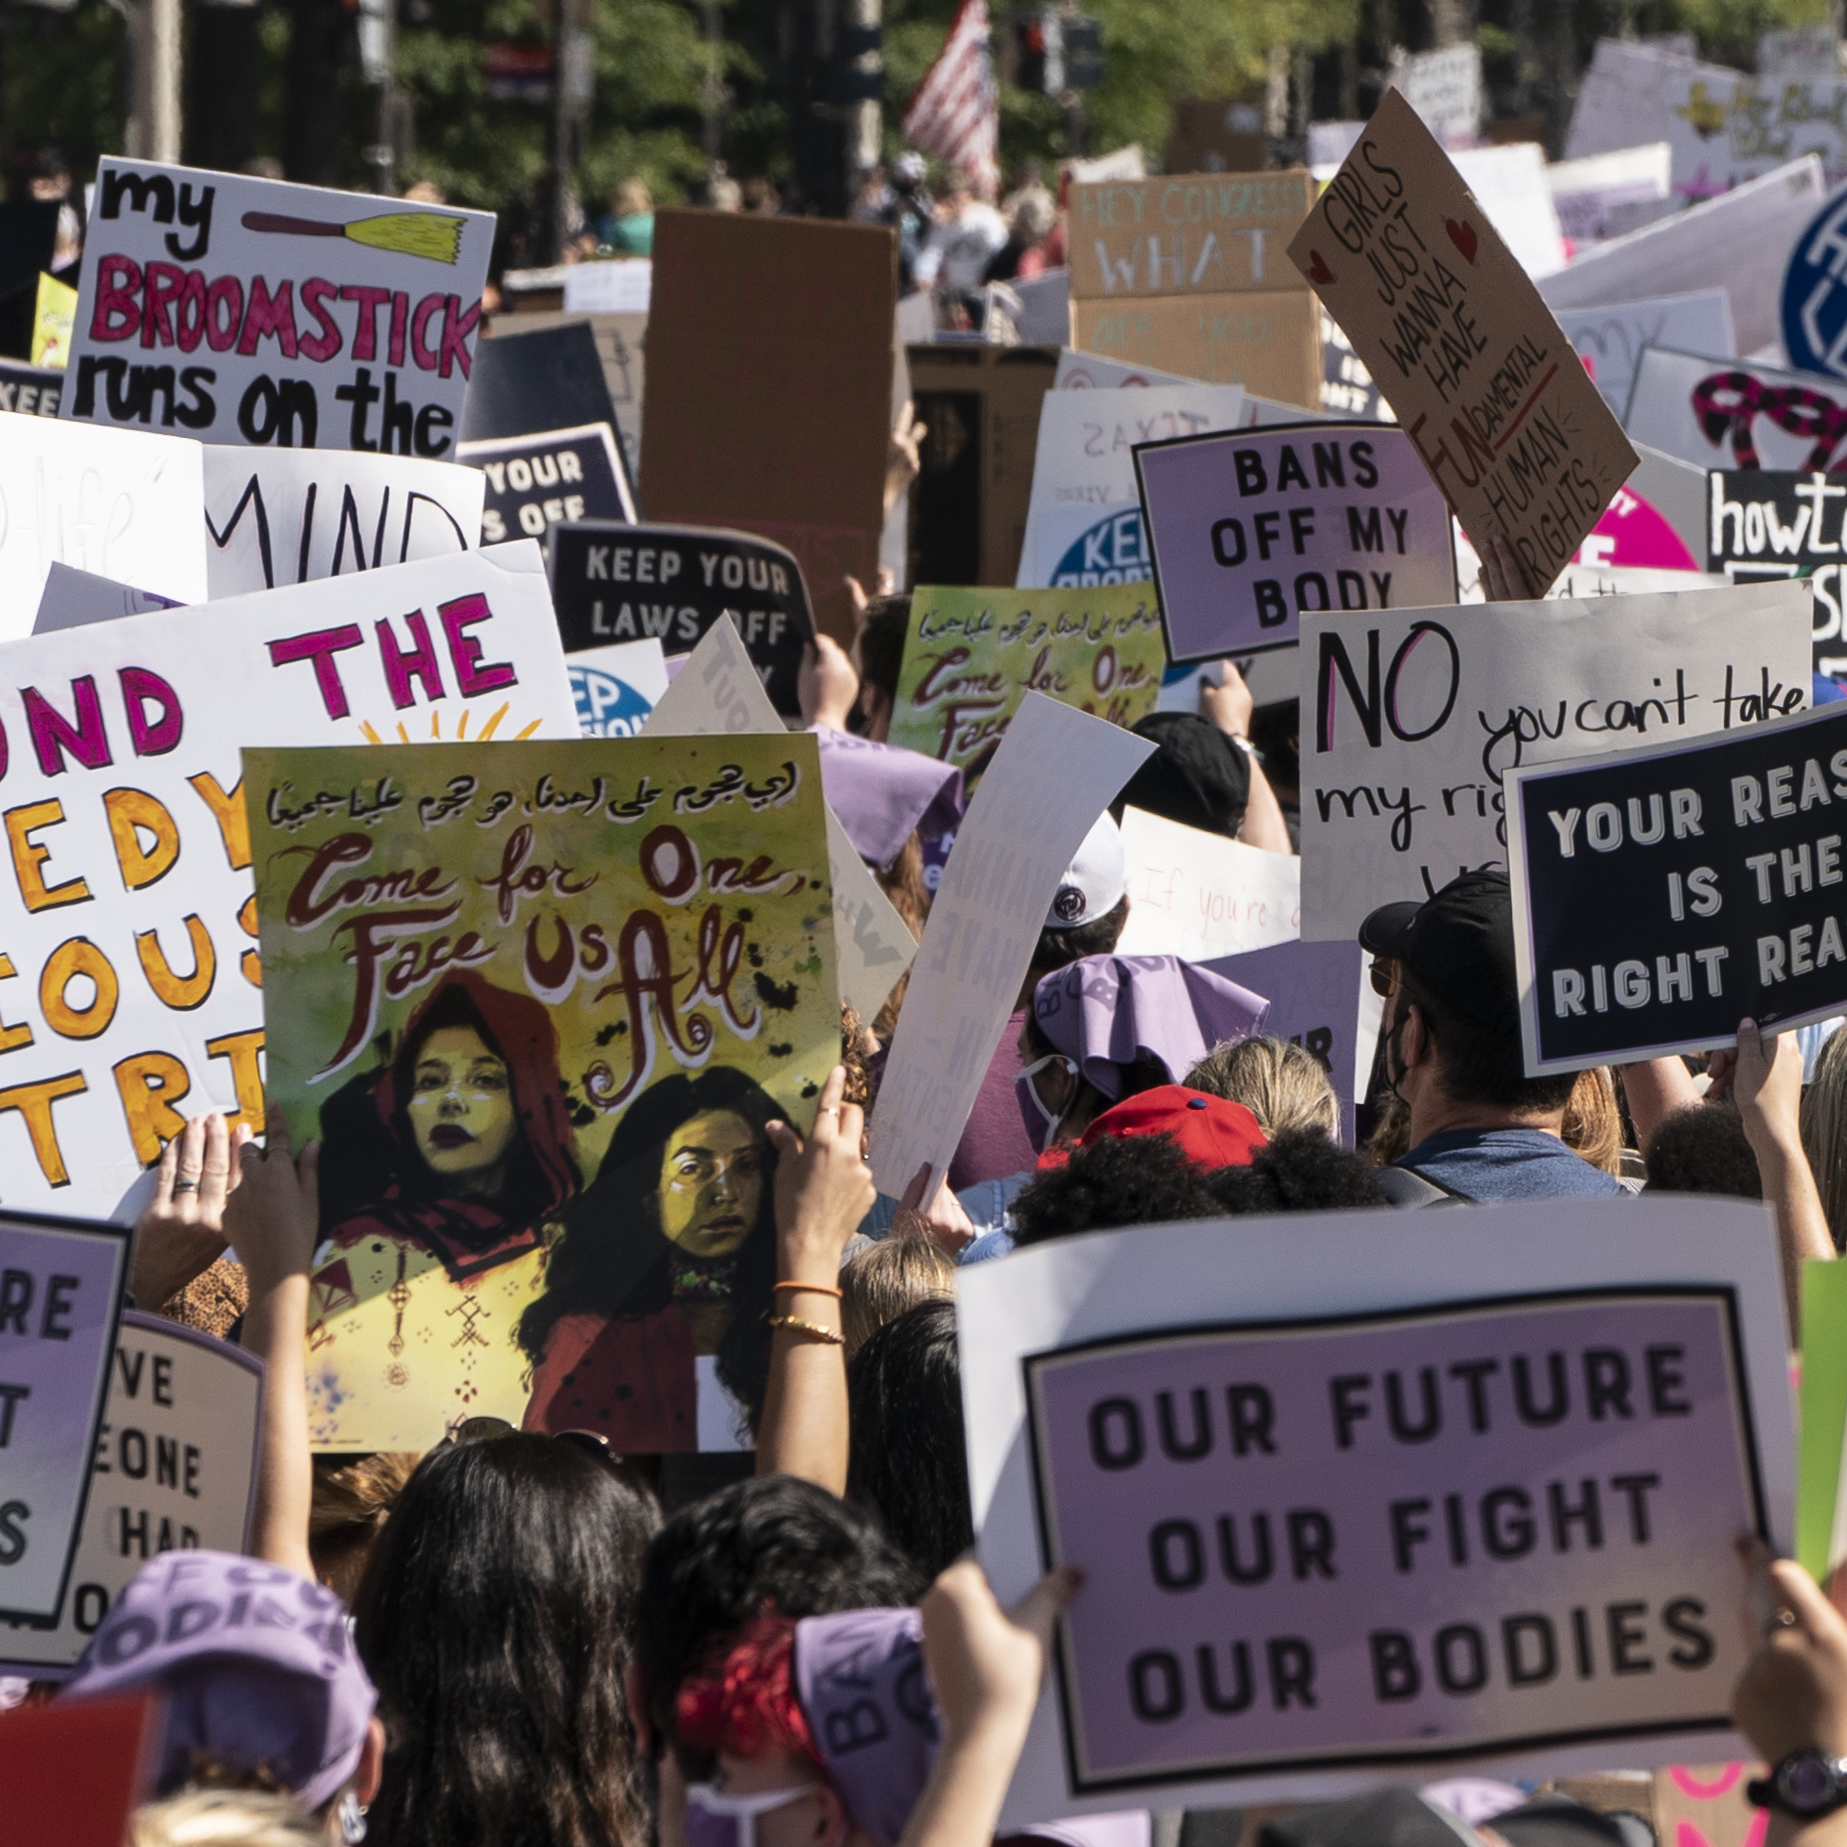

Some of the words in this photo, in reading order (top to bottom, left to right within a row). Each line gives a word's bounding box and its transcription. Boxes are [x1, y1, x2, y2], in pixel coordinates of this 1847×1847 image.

[100, 168, 216, 261] my
[1324, 140, 1403, 254] GIRLS
[1093, 228, 1272, 294] WHAT
[1367, 202, 1427, 306] JUST
[89, 253, 483, 381] BROOMSTICK
[1380, 257, 1467, 379] WANNA
[1424, 300, 1487, 404] HAVE
[72, 356, 218, 431] runs
[236, 374, 318, 448] on
[335, 368, 454, 455] the
[1233, 440, 1379, 497] BANS
[1482, 410, 1569, 533] HUMAN
[204, 473, 469, 589] MIND
[585, 545, 681, 585] KEEP
[701, 551, 790, 596] YOUR
[1210, 508, 1316, 567] OFF
[1346, 505, 1409, 554] MY
[1516, 458, 1601, 585] RIGHTS
[591, 607, 700, 638] LAWS
[1252, 570, 1393, 629] BODY
[264, 592, 519, 722] THE
[1316, 620, 1461, 754] NO
[1478, 700, 1568, 784] you
[1574, 667, 1699, 734] can't
[1713, 663, 1806, 729] take
[1314, 786, 1427, 852] my
[1547, 788, 1703, 858] YOUR
[266, 831, 458, 931] Come
[476, 823, 600, 924] for
[639, 823, 806, 904] One,
[1138, 865, 1184, 913] If
[1198, 884, 1269, 941] you're
[1667, 865, 1723, 922] IS
[1746, 834, 1844, 907] THE
[306, 897, 502, 1084] Face
[525, 913, 619, 1005] Us
[585, 903, 761, 1112] All
[1551, 946, 1732, 1020] RIGHT
[1086, 1384, 1277, 1472] OUR
[1328, 1344, 1693, 1453] FUTURE
[1148, 1509, 1338, 1594] OUR
[1388, 1473, 1663, 1574] FIGHT
[1125, 1637, 1319, 1725] OUR
[1368, 1595, 1718, 1704] BODIES
